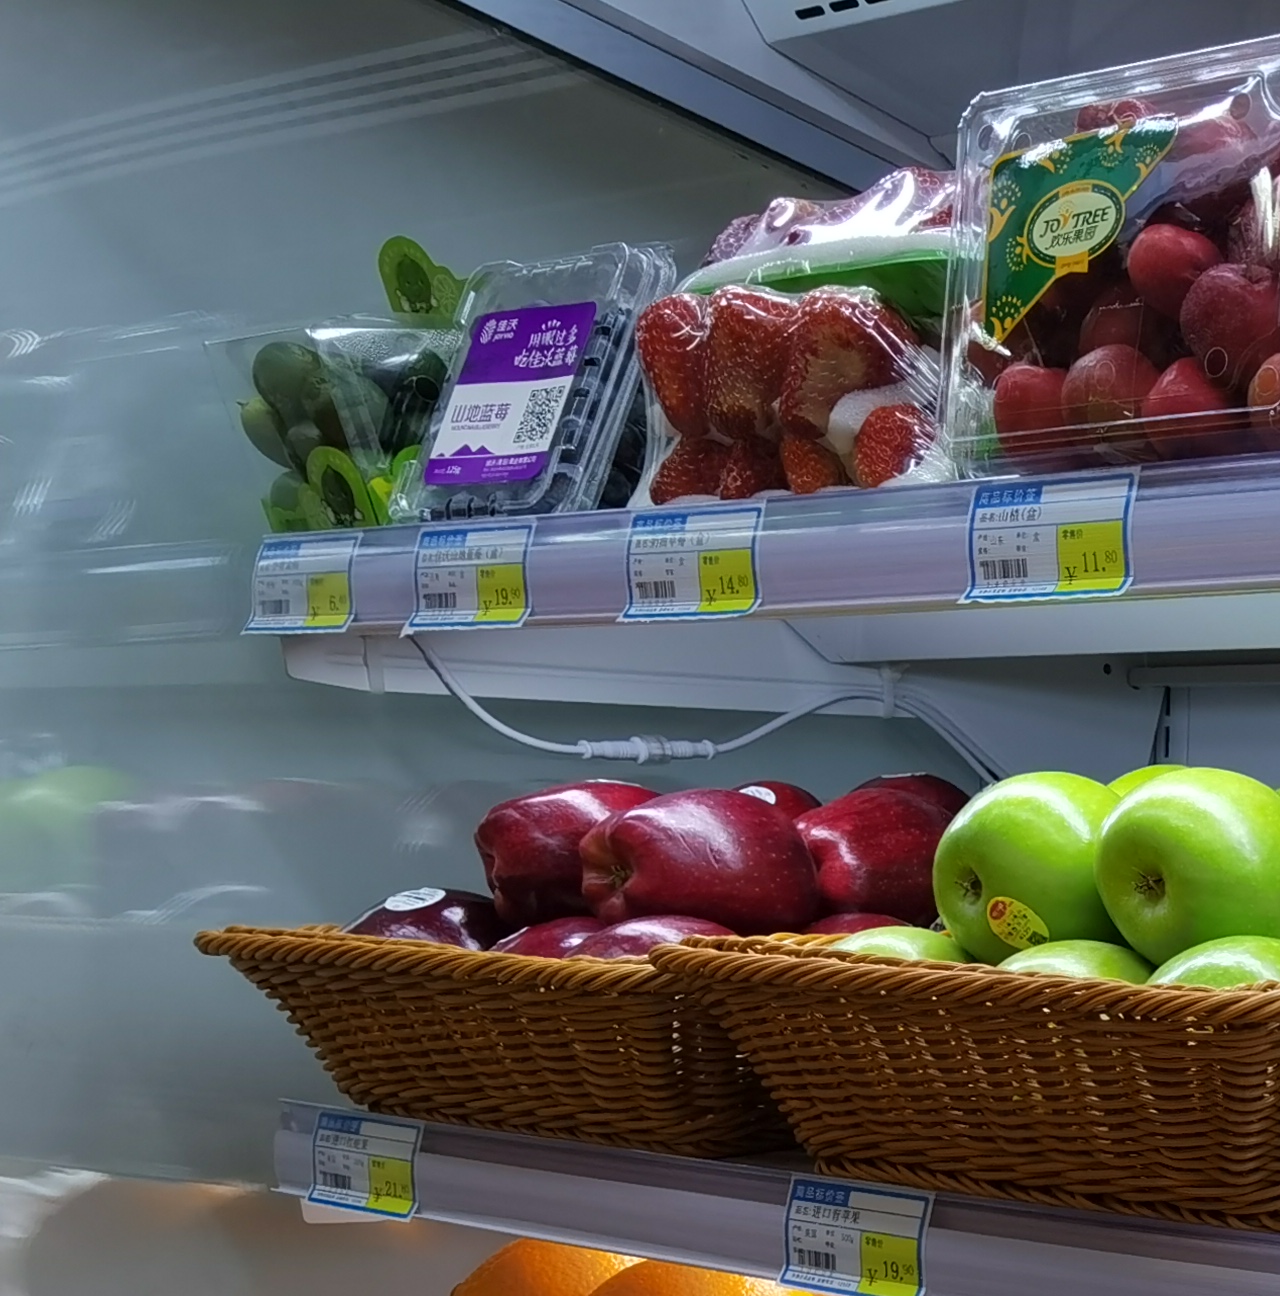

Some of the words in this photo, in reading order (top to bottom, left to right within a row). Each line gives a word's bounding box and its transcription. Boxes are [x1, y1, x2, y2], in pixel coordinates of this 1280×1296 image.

[1039, 211, 1073, 238] JOY
[1071, 206, 1112, 229] TREE
[1045, 225, 1099, 250] 欢乐果园
[528, 324, 578, 348] 用眼过多
[514, 345, 579, 368] 吃佳沃蓝莓
[451, 403, 511, 423] 山地蓝莓
[1082, 550, 1117, 573] 11.80
